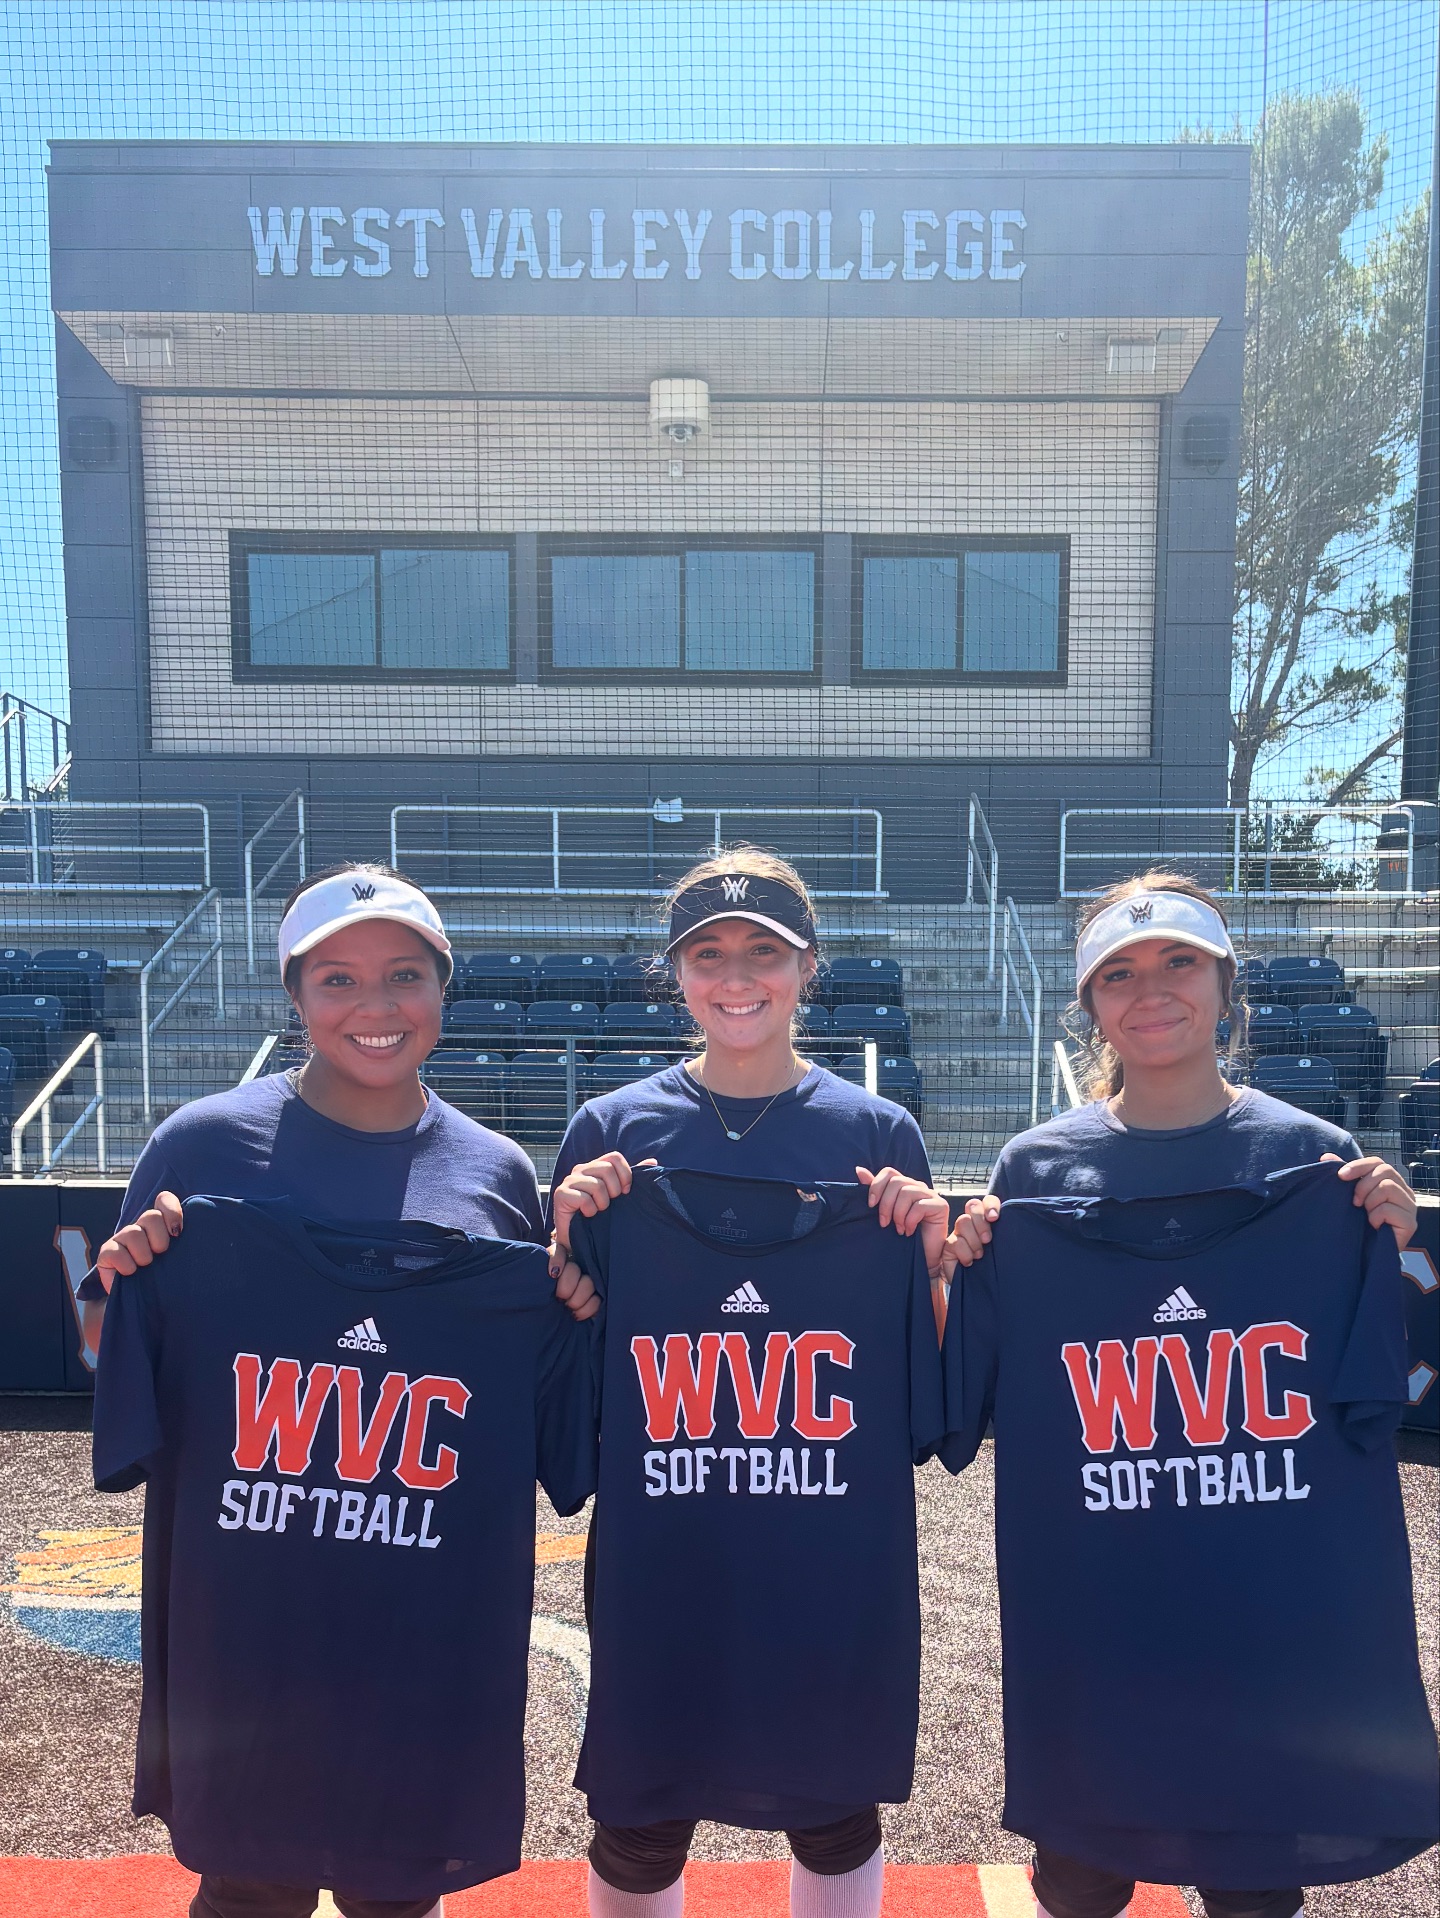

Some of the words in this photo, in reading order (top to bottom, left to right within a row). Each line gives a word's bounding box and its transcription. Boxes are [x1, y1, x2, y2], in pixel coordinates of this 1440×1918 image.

[246, 206, 446, 277] WEST
[460, 207, 713, 280] VALLEY
[728, 208, 1028, 282] COLLEGE
[720, 1299, 771, 1315] adidas
[1152, 1307, 1208, 1324] adidas
[336, 1335, 388, 1354] adidas
[629, 1330, 858, 1443] WVC
[1060, 1320, 1318, 1455] WVC
[231, 1352, 473, 1491] WVC
[643, 1446, 850, 1497] SOFTBALL
[1080, 1447, 1312, 1512] SOFTBALL
[216, 1479, 443, 1549] SOFTBALL
